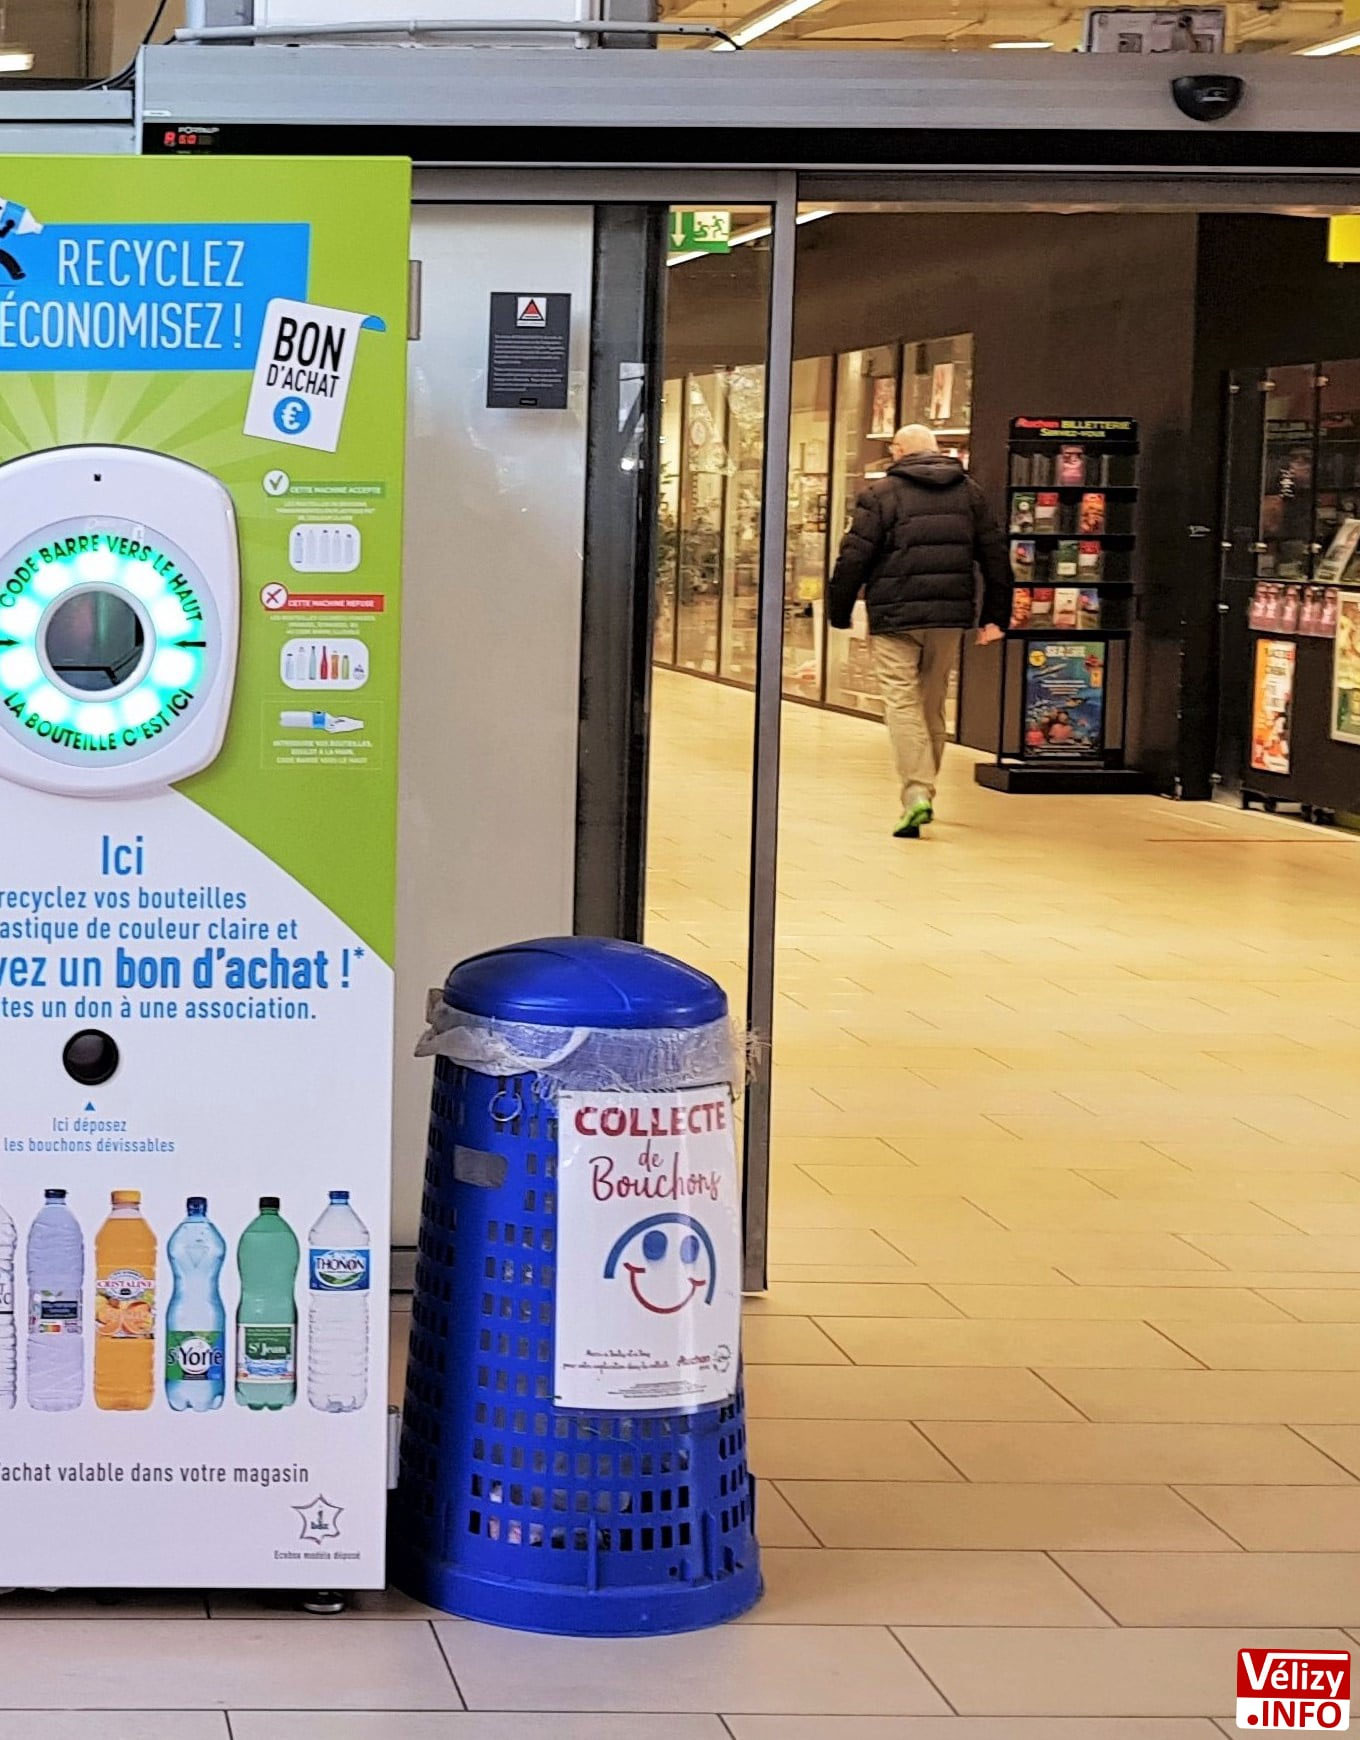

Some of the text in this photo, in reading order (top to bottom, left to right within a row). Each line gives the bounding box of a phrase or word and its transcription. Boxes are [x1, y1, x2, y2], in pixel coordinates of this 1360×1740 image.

[57, 239, 246, 288] RECYCLEZ
[272, 316, 347, 373] BON
[266, 364, 340, 399] D'ACHAT
[38, 534, 100, 564] BARRE
[106, 535, 152, 562] VERS
[152, 554, 175, 577] LE
[168, 573, 204, 621] HAUT
[4, 689, 195, 752] LA BOUTEILLE C'EST ICI
[101, 835, 144, 876] Ici
[94, 891, 130, 909] vos
[138, 886, 247, 909] bouteilles
[86, 917, 111, 940] de
[118, 917, 201, 940] couleur
[207, 917, 270, 940] claire
[276, 919, 298, 940] et
[59, 955, 101, 987] un
[115, 947, 181, 989] bon
[192, 947, 329, 989] d'achat
[42, 1000, 68, 1018] un
[74, 996, 113, 1018] don
[120, 996, 131, 1018] à
[140, 1001, 179, 1018] une
[185, 996, 318, 1019] association.
[52, 1117, 128, 1136] Ici déposez
[574, 1101, 726, 1138] COLLECTE
[3, 1136, 176, 1153] les bouchons dévissables
[638, 1138, 664, 1173] de
[588, 1151, 722, 1201] Bouchons
[316, 1257, 365, 1270] THONON
[261, 1343, 288, 1356] Jean
[58, 1462, 124, 1482] valable
[131, 1462, 174, 1482] dans
[180, 1466, 227, 1482] votre
[233, 1463, 309, 1488] magasin
